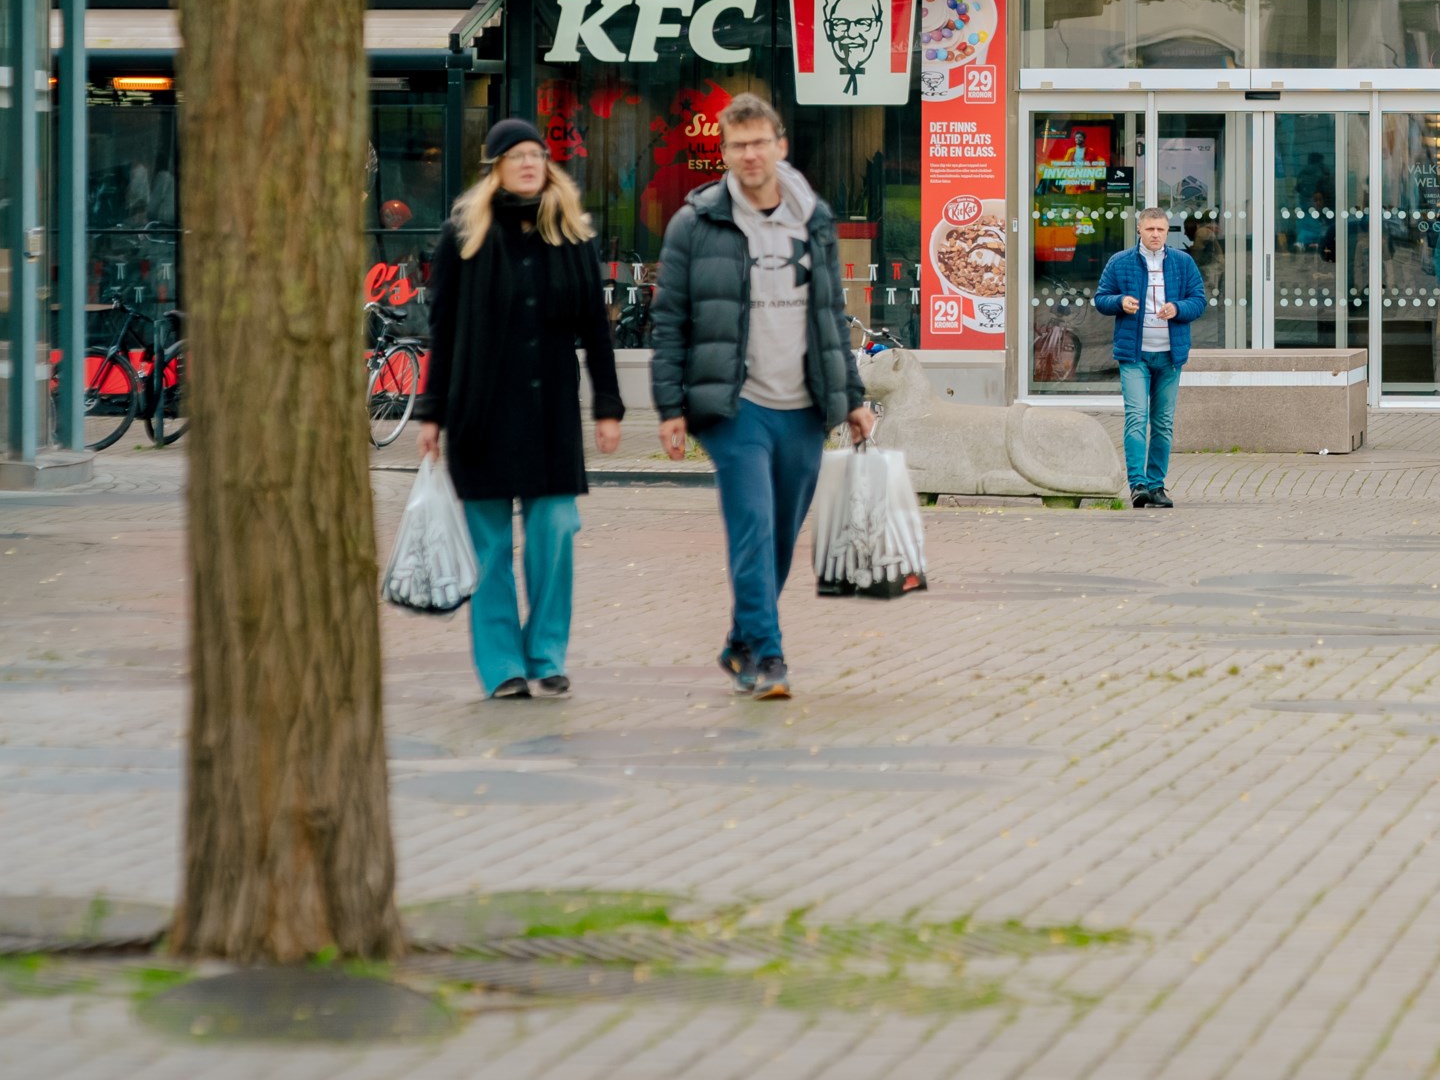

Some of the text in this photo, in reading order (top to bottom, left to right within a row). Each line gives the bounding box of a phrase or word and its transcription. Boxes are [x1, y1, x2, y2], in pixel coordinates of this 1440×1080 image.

[968, 71, 992, 91] 29
[930, 122, 977, 132] DET FINNS
[930, 134, 991, 144] ALLTID PLATS
[929, 144, 996, 157] FÖR EN GLASS.
[688, 159, 713, 170] EST.
[951, 202, 976, 220] KitKat
[934, 301, 958, 321] 29
[934, 321, 959, 329] KRONOR
